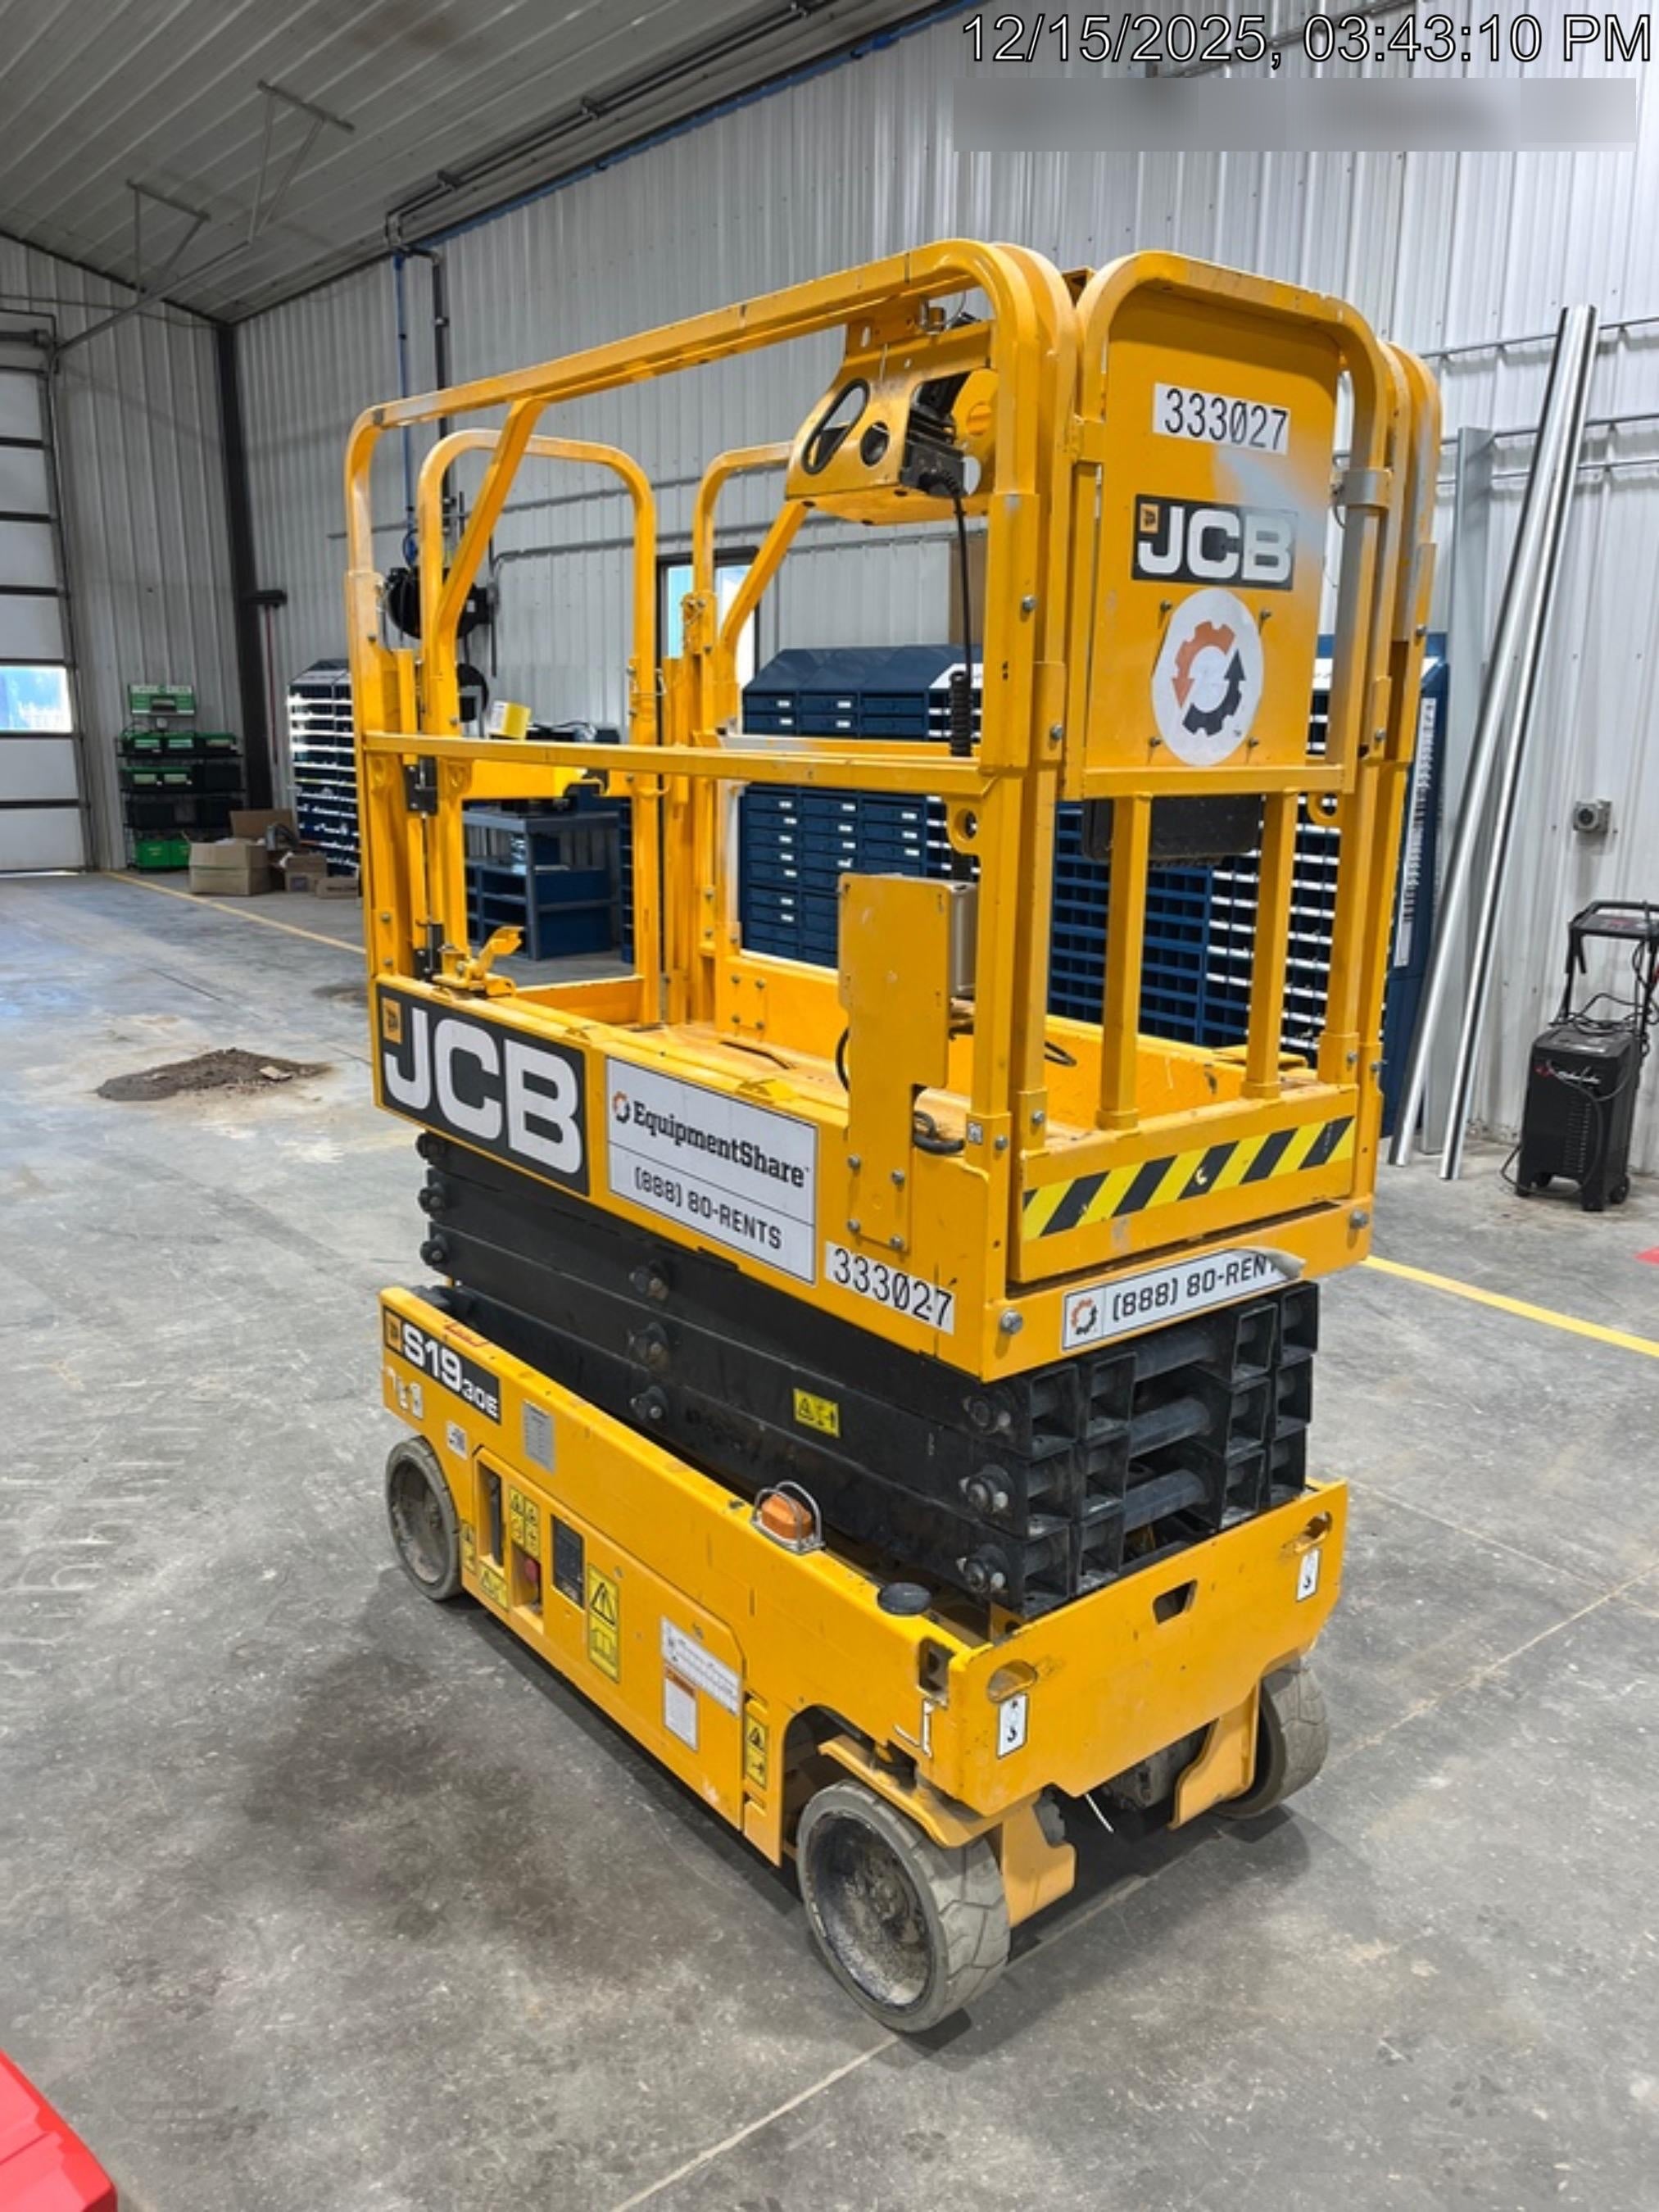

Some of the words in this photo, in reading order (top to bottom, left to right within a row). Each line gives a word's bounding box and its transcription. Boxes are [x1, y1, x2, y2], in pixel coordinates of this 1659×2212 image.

[1165, 388, 1289, 451] 333027
[1137, 505, 1293, 582] JCB
[383, 1005, 584, 1176] JCB
[633, 1100, 805, 1188] EquipmentShare
[634, 1166, 682, 1208] (888)
[687, 1190, 782, 1250] 80-RENTS
[834, 1248, 953, 1327] 333027
[1112, 1277, 1178, 1321] (888)
